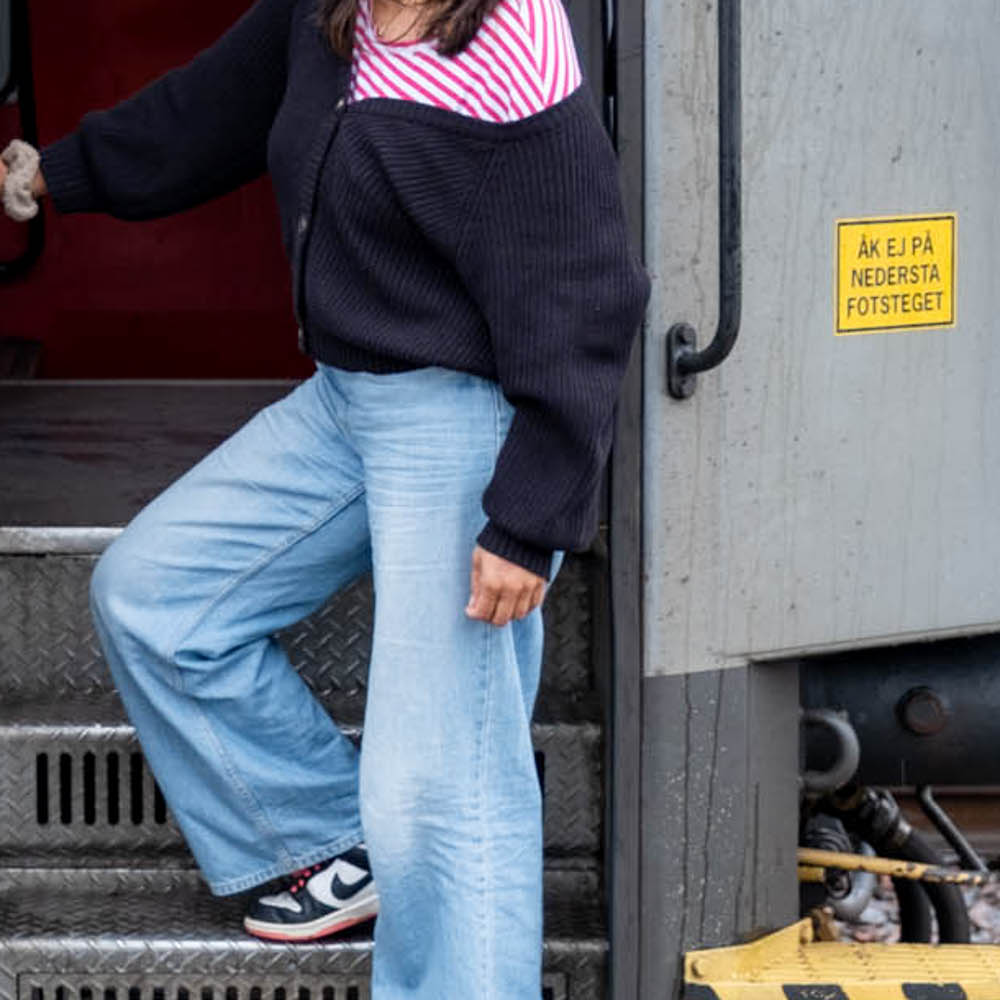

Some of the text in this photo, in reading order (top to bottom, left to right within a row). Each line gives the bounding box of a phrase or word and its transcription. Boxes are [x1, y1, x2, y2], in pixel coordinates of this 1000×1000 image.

[858, 230, 935, 258] ÅK EJ PÅ
[851, 264, 941, 288] NEDERSTA
[846, 291, 944, 318] FOTSTEGET
